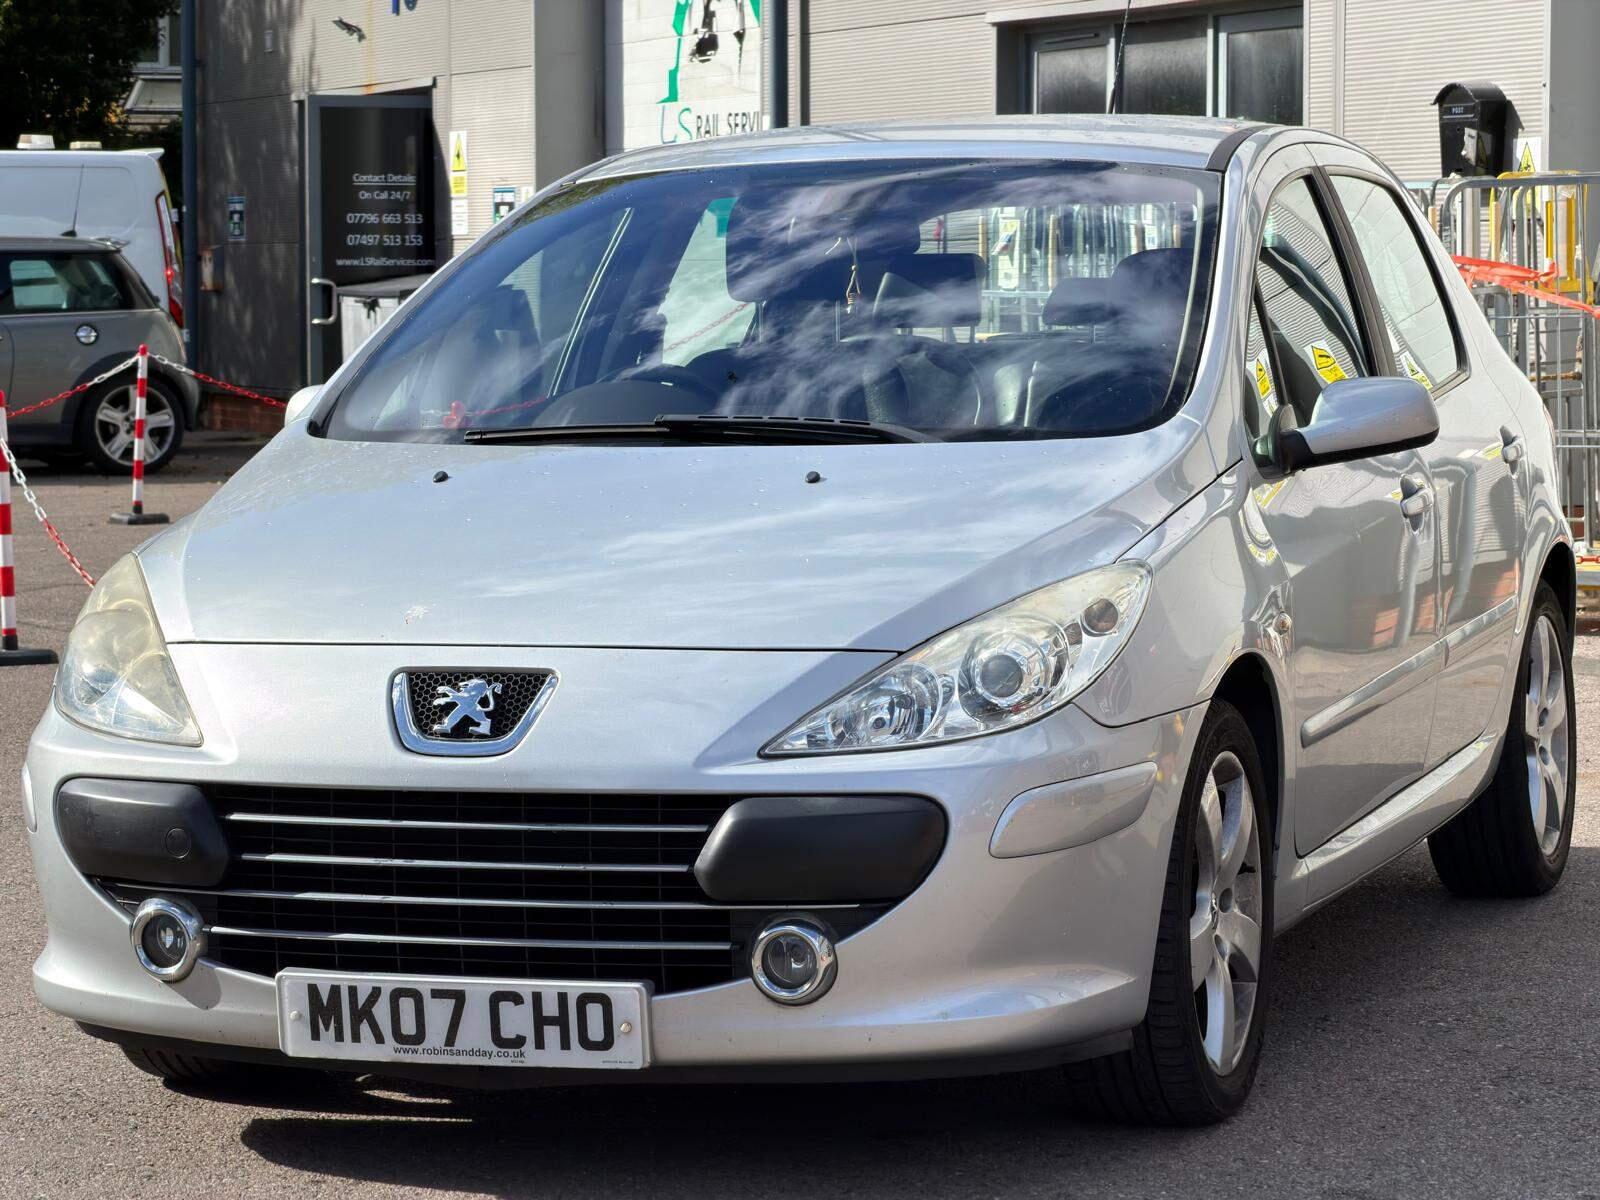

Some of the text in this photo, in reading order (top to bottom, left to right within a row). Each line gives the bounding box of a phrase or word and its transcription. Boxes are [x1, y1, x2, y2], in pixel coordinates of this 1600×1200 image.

[1452, 106, 1464, 114] POST
[696, 113, 720, 139] RAIL
[352, 173, 385, 183] Contact
[359, 190, 411, 201] On Call 24/7
[346, 213, 423, 224] 07796 663 513
[346, 235, 423, 246] 07497 513 153
[335, 257, 435, 266] www.LSRailServices.com
[307, 983, 614, 1051] MK07 CHO
[393, 1045, 526, 1060] www.robinsandday.co.uk
